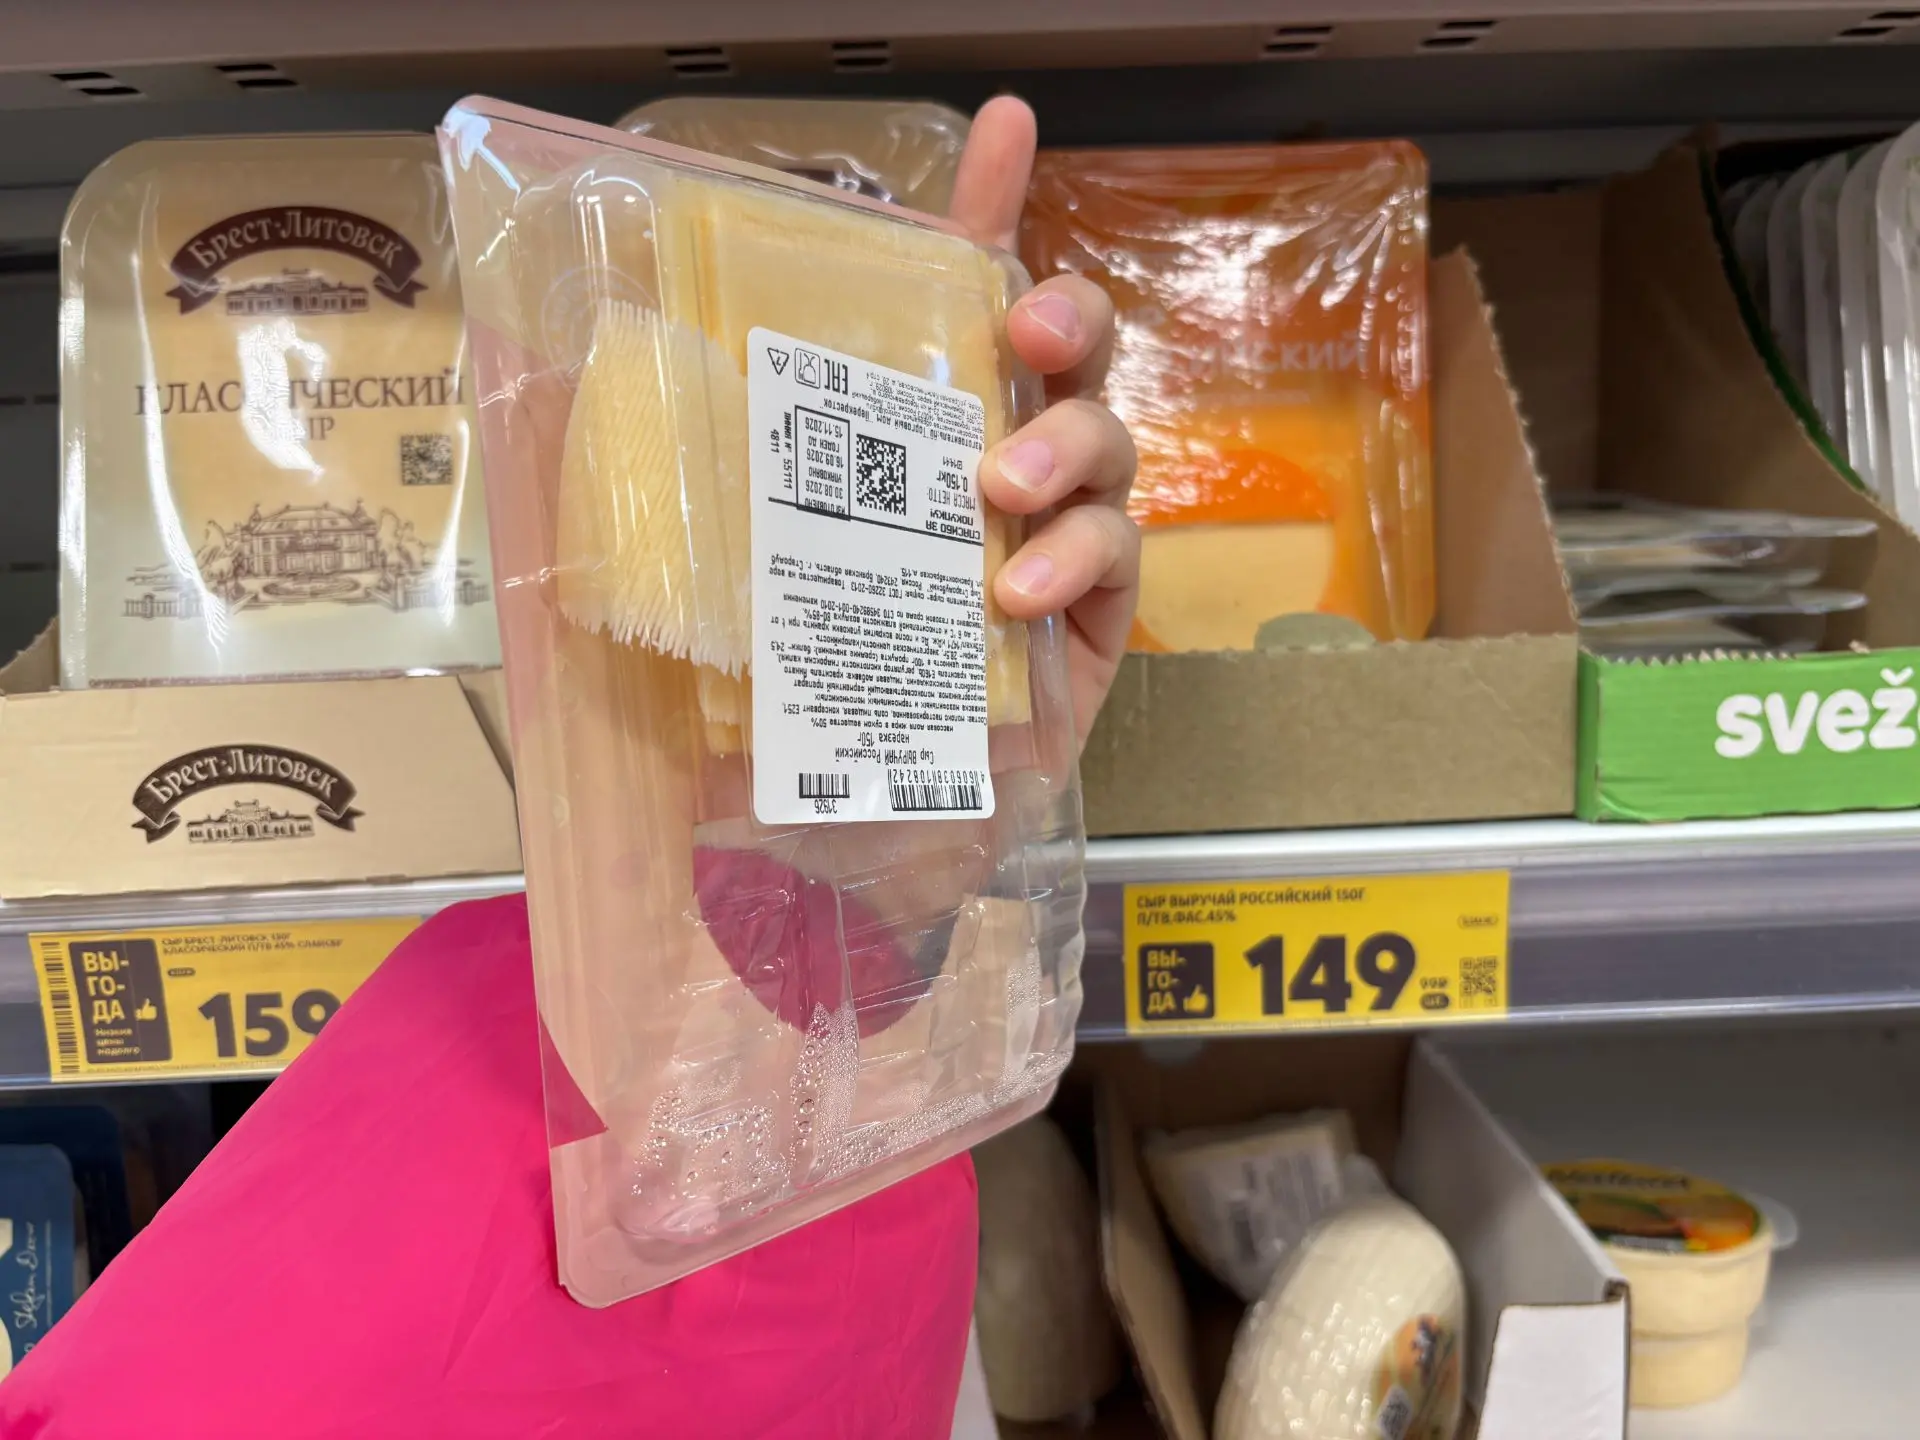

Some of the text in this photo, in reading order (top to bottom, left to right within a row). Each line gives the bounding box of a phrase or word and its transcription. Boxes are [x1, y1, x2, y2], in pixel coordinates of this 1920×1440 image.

[135, 367, 466, 415] ЛАСЧЕСКИЙ
[804, 416, 844, 439] 15.11.2026
[770, 428, 780, 454] 4811
[808, 435, 840, 453] ГОДЕН ДО
[806, 448, 845, 469] 16.09.2026
[783, 458, 793, 490] 55111
[808, 466, 842, 484] УПАКОВАНО
[936, 470, 968, 492] 0,150кг
[805, 479, 844, 500] 30.08.2026
[953, 493, 976, 511] МАССА
[929, 508, 974, 526] ПОКУПКУ!
[925, 519, 981, 540] СПАСИБО ЗА
[1714, 666, 1920, 759] svež
[857, 731, 910, 748] нарезка 150г
[835, 748, 934, 765] Сыр ВЫРУЧАЙ Российский
[814, 798, 838, 814] 31926
[1137, 885, 1366, 909] СЫР ВЫРУЧАЙ РОССИЙСКИЙ 150Г
[82, 951, 129, 973] ВЫ-
[1147, 950, 1186, 969] ВЫ-
[1147, 970, 1181, 989] ГО-
[1243, 931, 1416, 1015] 149
[86, 976, 125, 996] ГО-
[92, 1000, 126, 1024] ДА
[1147, 991, 1176, 1014] ДА
[198, 988, 343, 1058] 159
